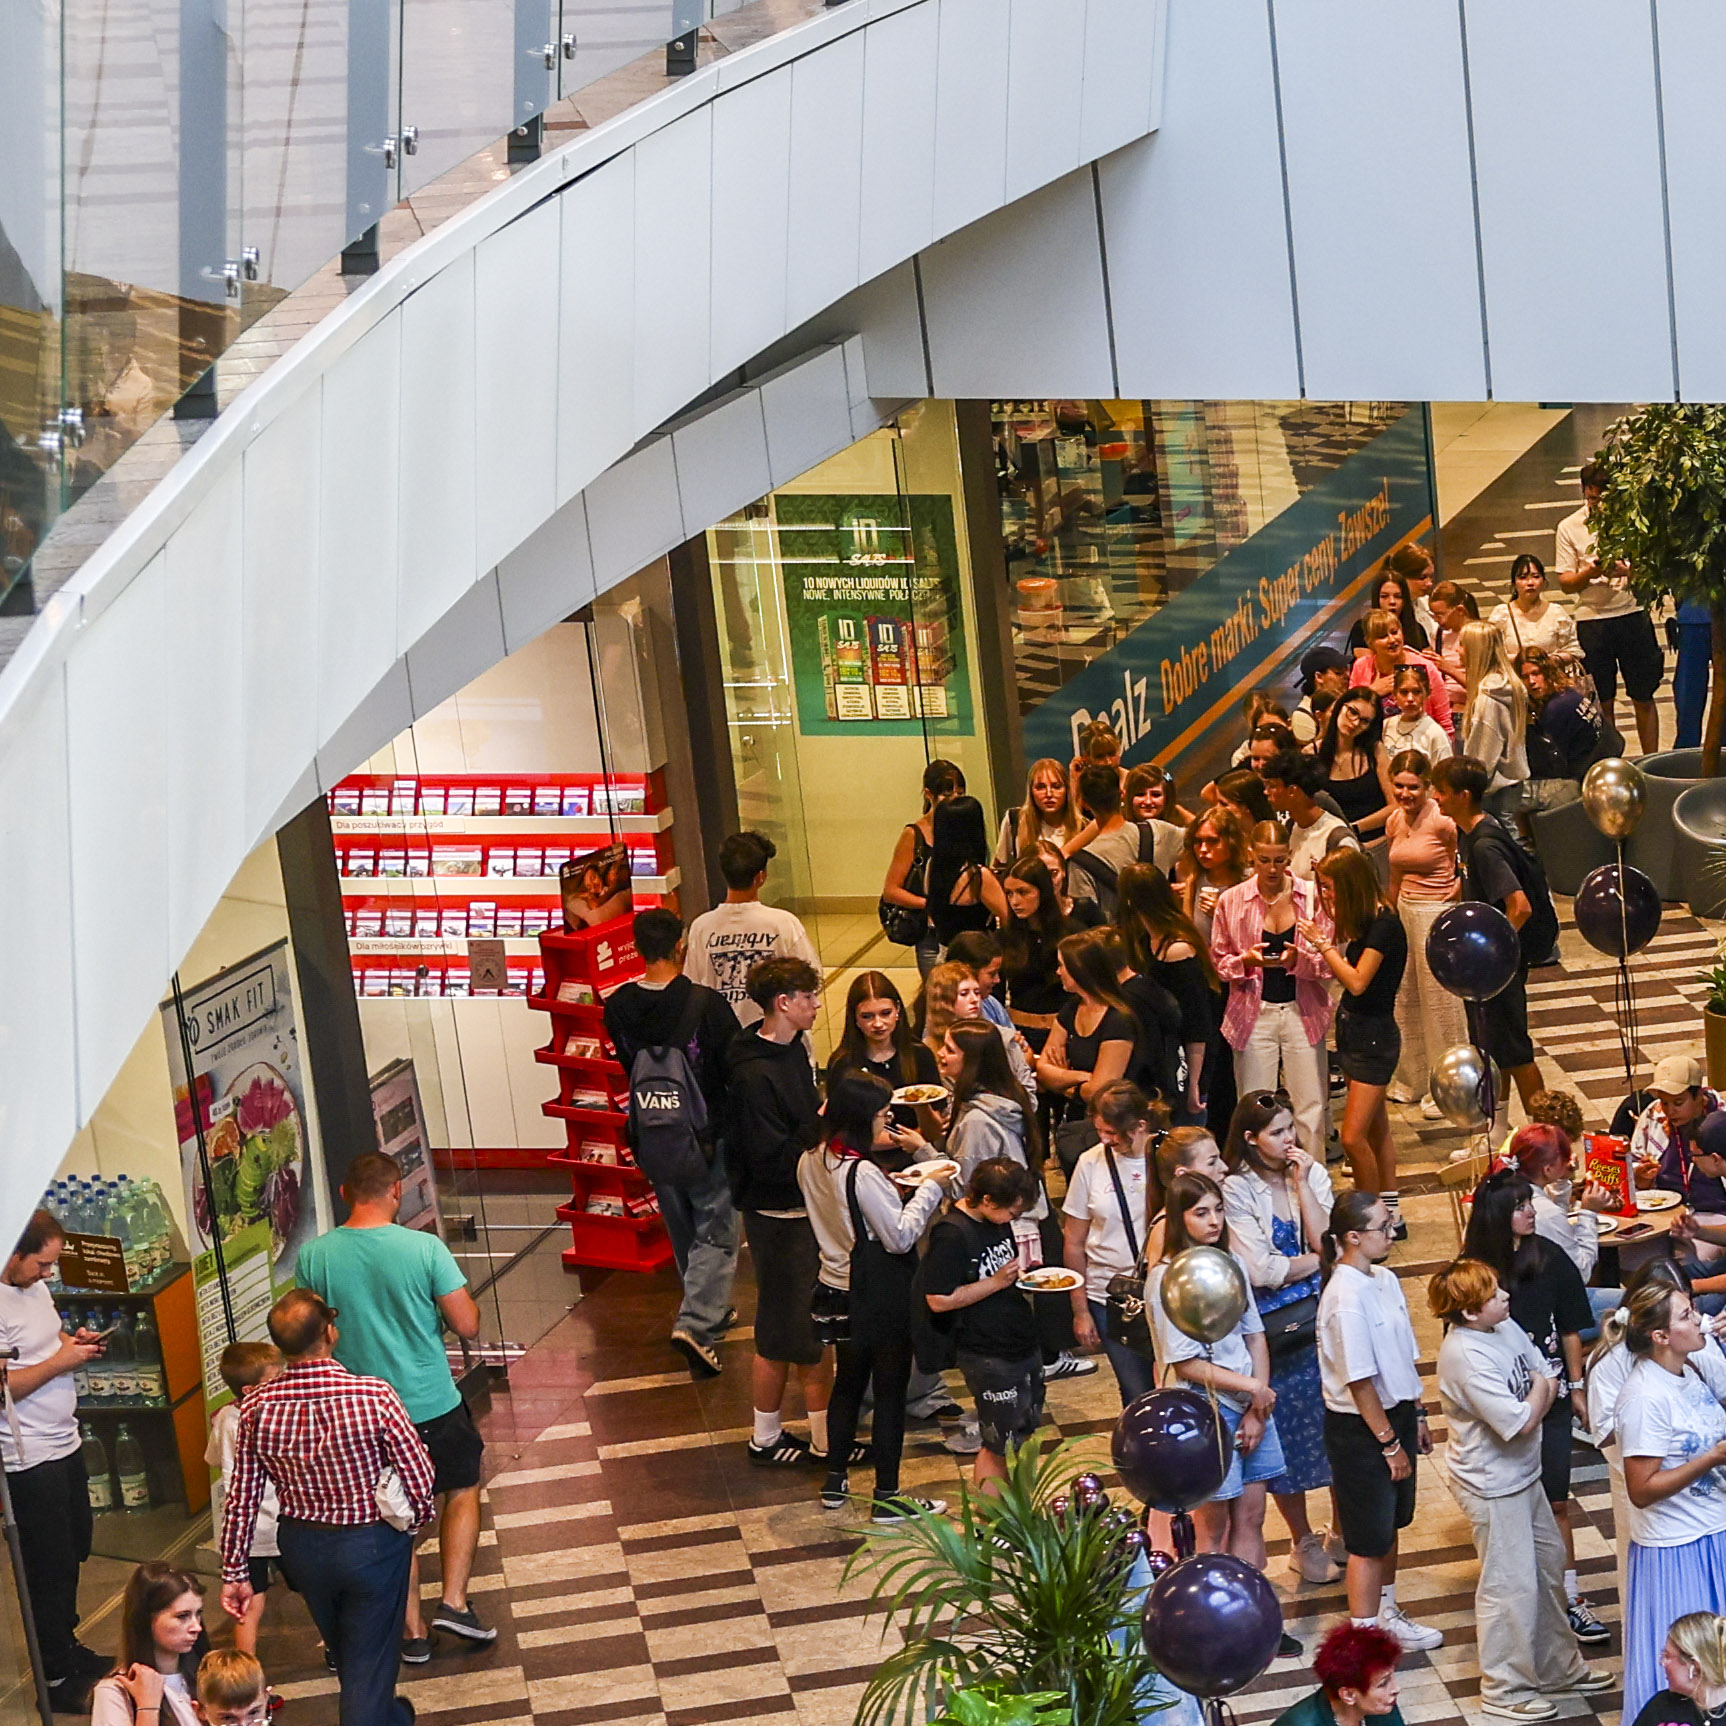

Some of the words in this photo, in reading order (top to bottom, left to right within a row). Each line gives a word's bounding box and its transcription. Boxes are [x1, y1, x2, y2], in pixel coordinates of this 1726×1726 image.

[803, 577, 814, 589] 10
[816, 577, 854, 590] NOWYCH
[855, 575, 899, 590] LIQUIDÓW
[833, 589, 886, 601] INTENSYWNE
[1160, 641, 1208, 715] Dobre
[1259, 561, 1301, 629] Super
[1337, 477, 1390, 562] Zawsze!
[1071, 669, 1152, 758] Dalz
[336, 821, 349, 830] Dla
[356, 942, 369, 951] Dla
[706, 931, 780, 950] Arbitrary
[206, 996, 241, 1034] SMAK
[246, 982, 264, 1013] FIT
[636, 1091, 681, 1110] VANS
[982, 1386, 1018, 1404] chaos
